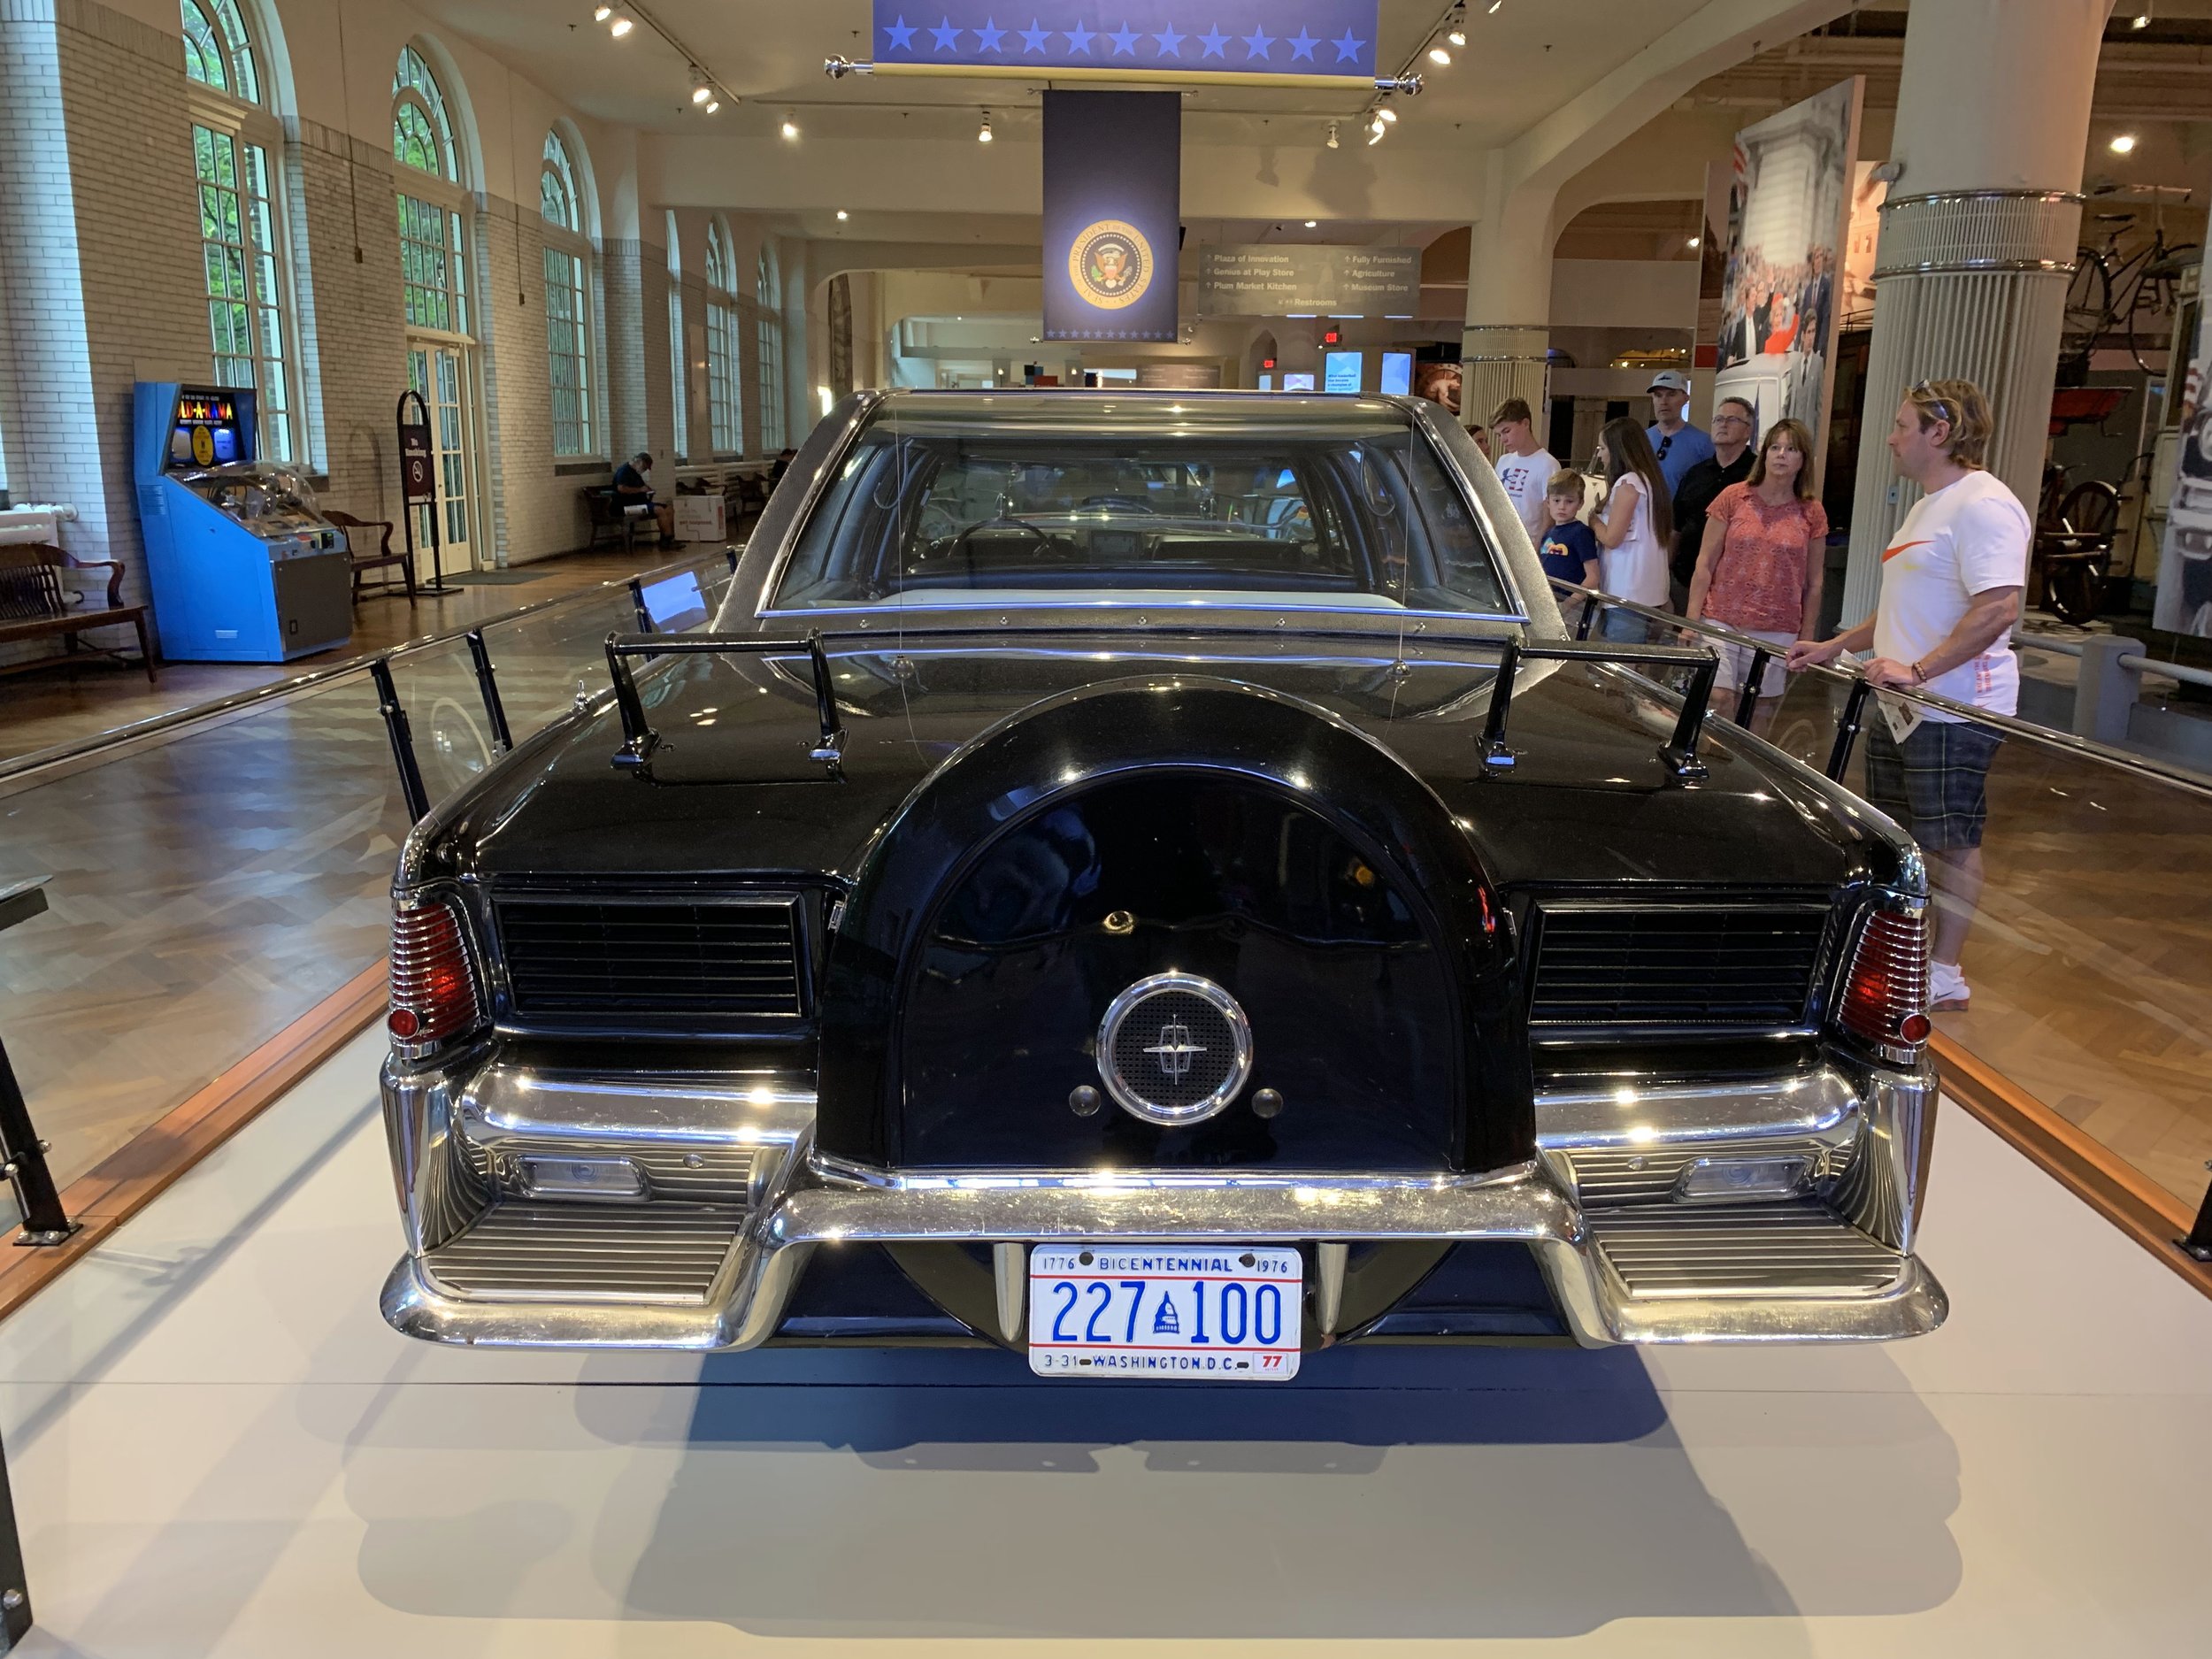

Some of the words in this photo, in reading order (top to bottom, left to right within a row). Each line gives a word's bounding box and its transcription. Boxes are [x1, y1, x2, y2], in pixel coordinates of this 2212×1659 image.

[1072, 223, 1110, 262] PRESIDENT
[1133, 234, 1150, 273] UNITED
[1352, 256, 1371, 265] Fully
[1352, 269, 1395, 278] Agriculture
[1119, 279, 1147, 303] STATES
[1042, 1256, 1075, 1270] 1776
[1098, 1257, 1233, 1272] BICENTENNIAL
[1256, 1260, 1288, 1273] 1976
[1052, 1280, 1146, 1343] 227
[1190, 1280, 1281, 1345] 100
[1044, 1355, 1078, 1367] 3-31
[1263, 1356, 1282, 1368] 77
